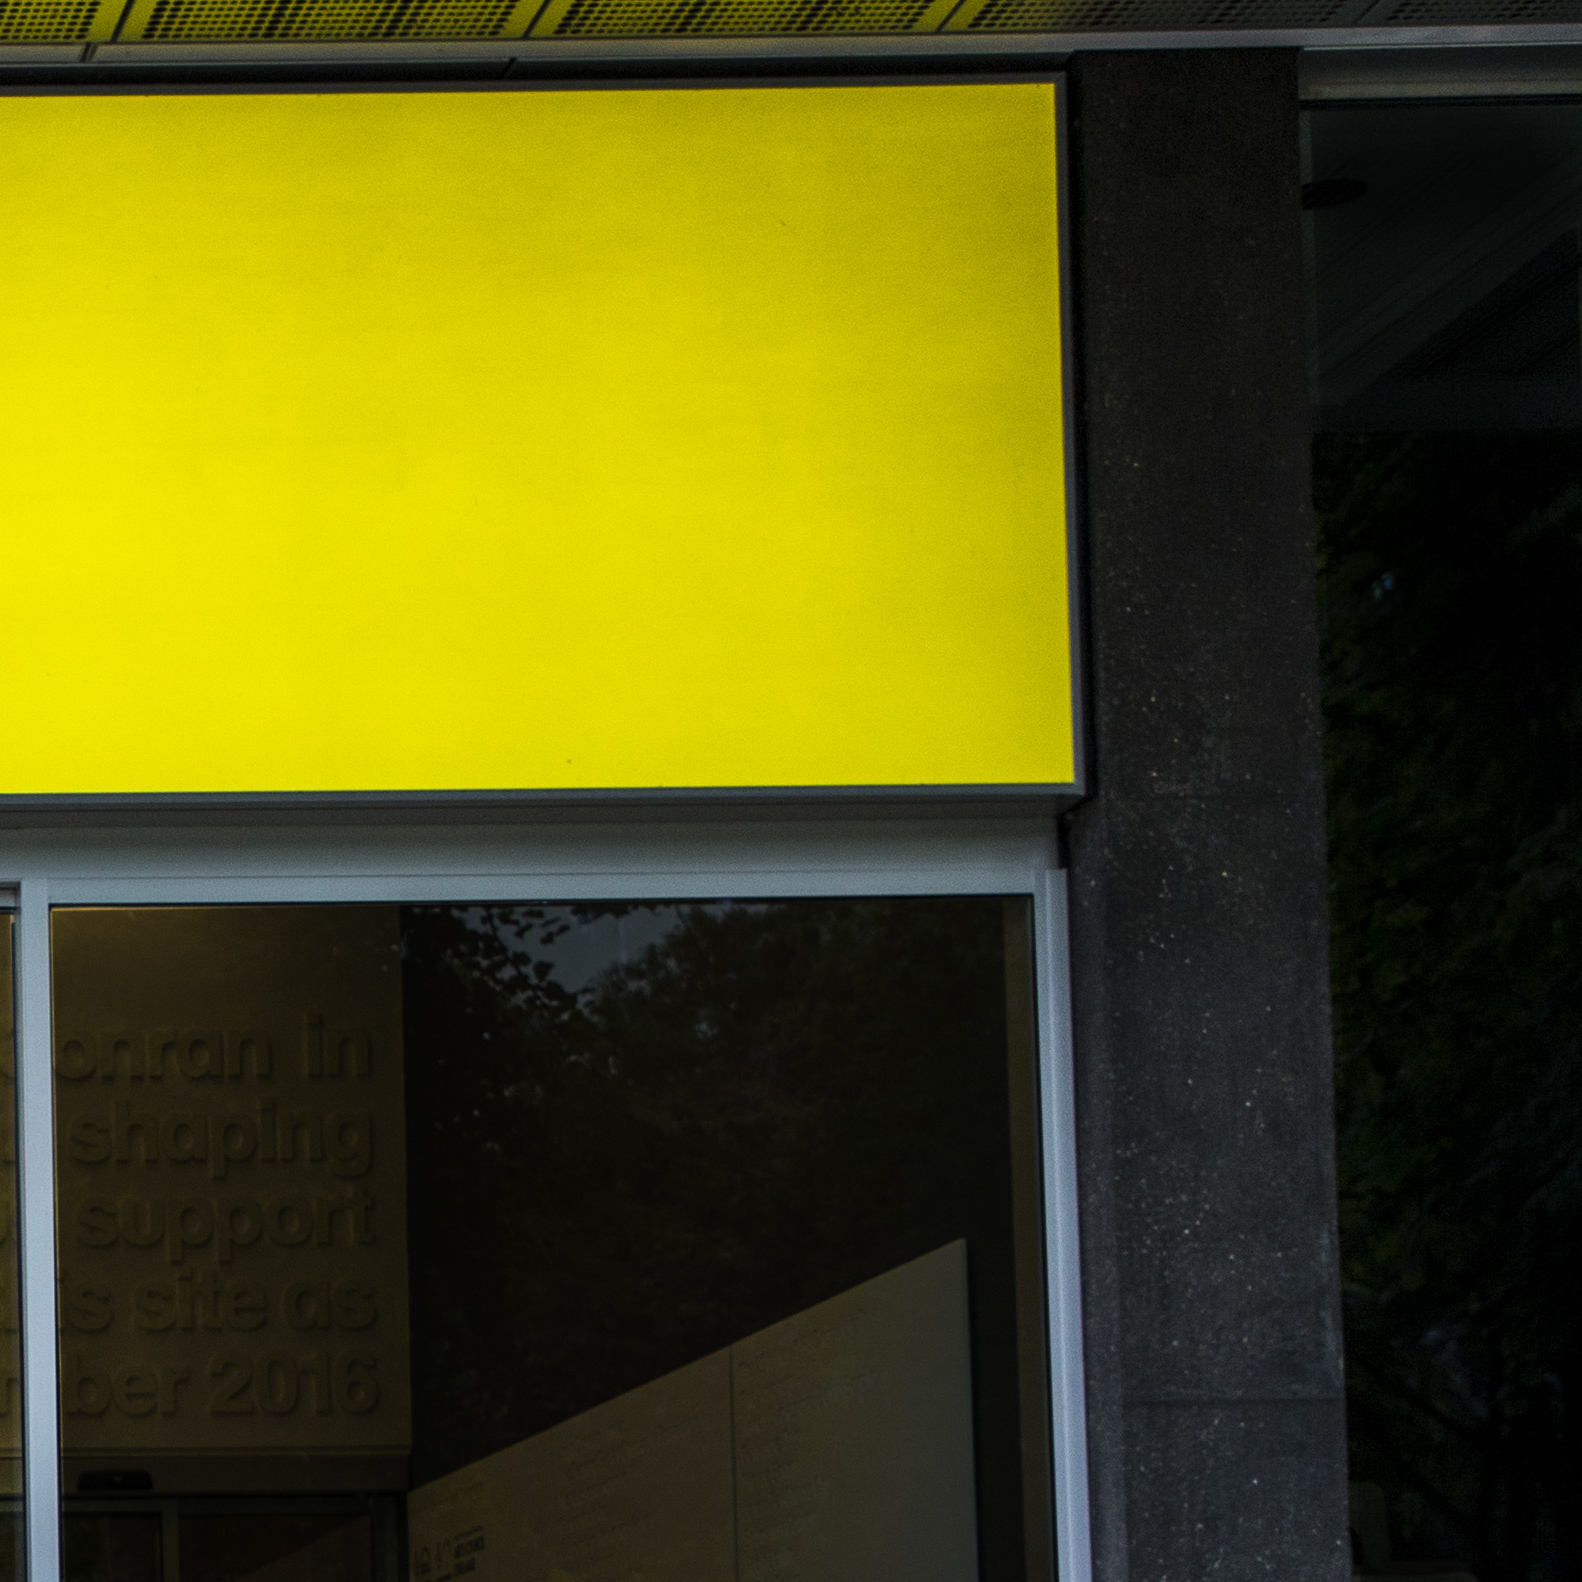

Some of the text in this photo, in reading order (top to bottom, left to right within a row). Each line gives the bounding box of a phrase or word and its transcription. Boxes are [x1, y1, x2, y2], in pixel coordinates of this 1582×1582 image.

[303, 1010, 372, 1080] in
[70, 1097, 376, 1180] shaping
[76, 1190, 378, 1266] support
[134, 1268, 269, 1334] site
[283, 1278, 378, 1332] as
[209, 1349, 382, 1418] 2016
